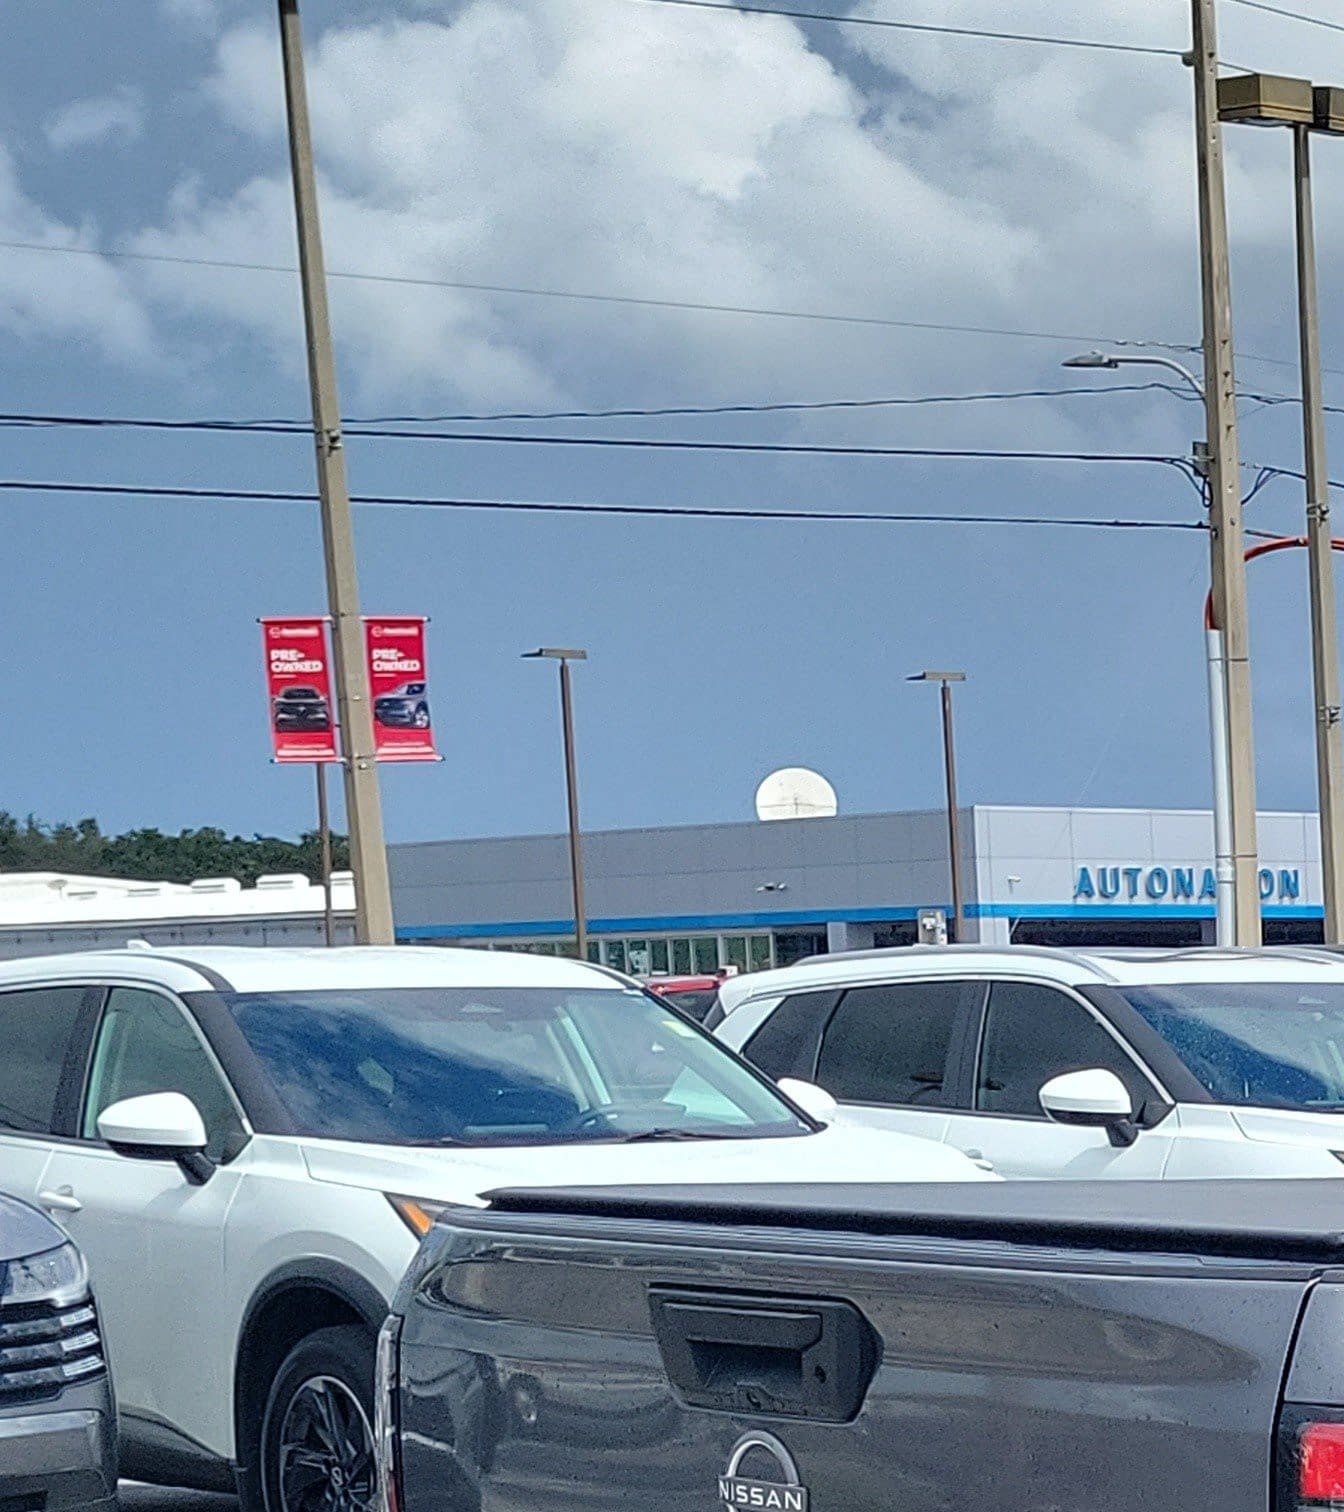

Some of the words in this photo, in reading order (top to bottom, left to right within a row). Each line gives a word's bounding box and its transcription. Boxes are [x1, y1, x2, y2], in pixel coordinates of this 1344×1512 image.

[271, 660, 323, 672] OWNED
[1075, 867, 1300, 900] AUTONAON
[719, 1480, 803, 1511] NISSAN
